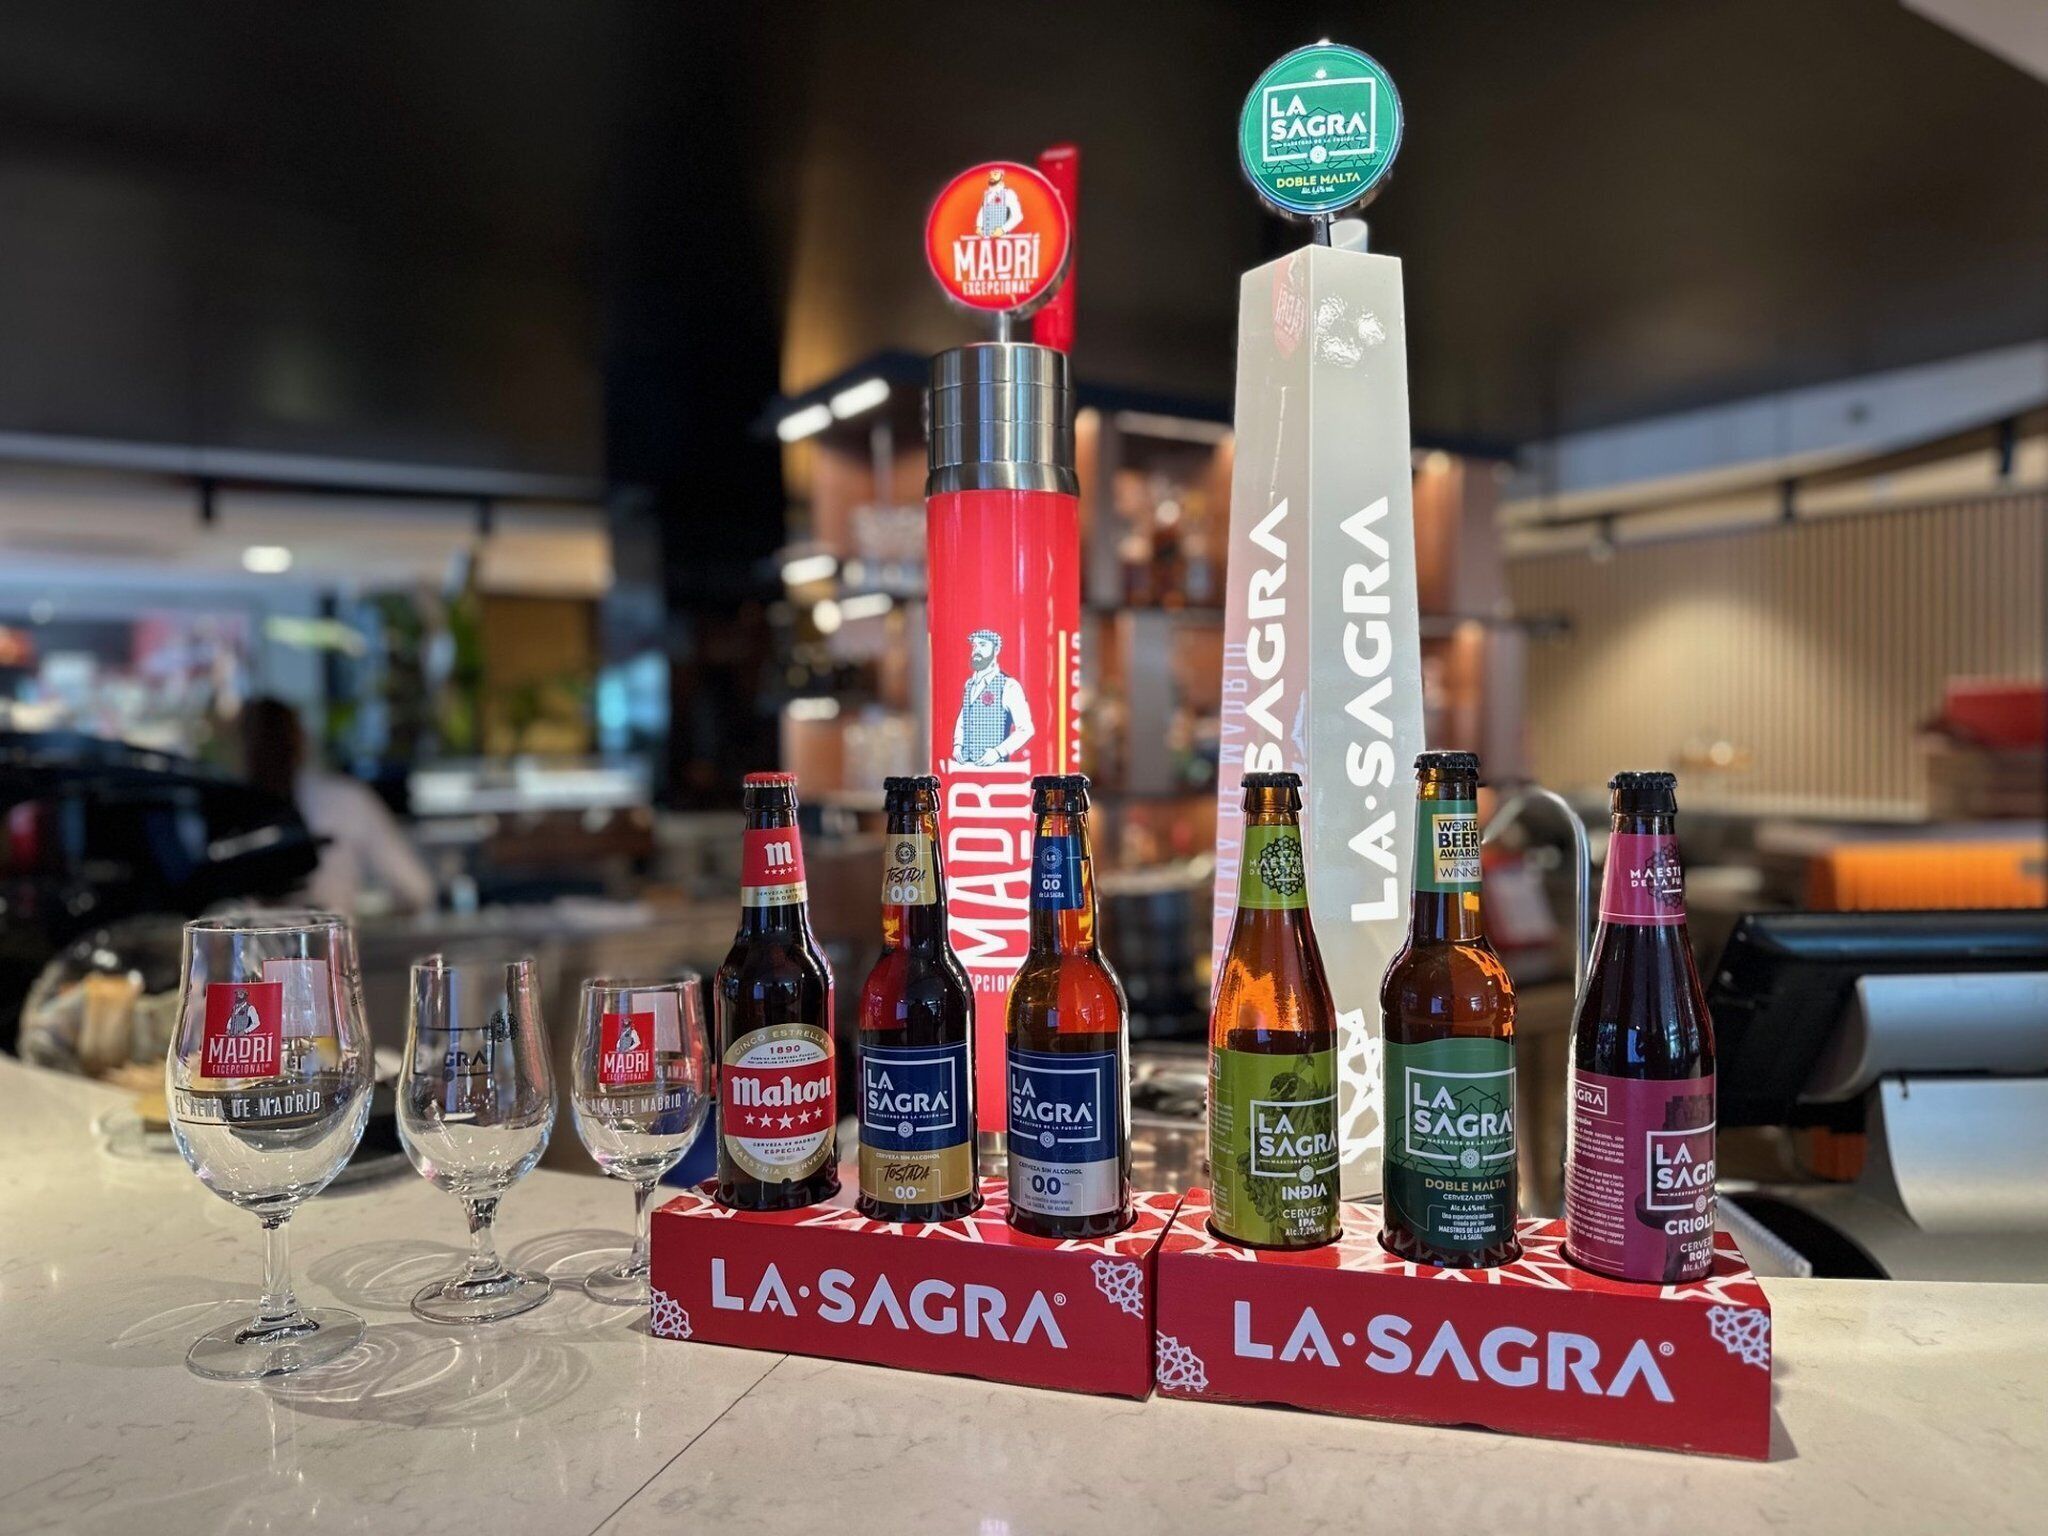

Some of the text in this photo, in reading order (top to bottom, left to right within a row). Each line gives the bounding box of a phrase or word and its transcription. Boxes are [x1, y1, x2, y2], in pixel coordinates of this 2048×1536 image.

[1271, 94, 1307, 118] LA
[1271, 112, 1367, 140] SAGRA
[1276, 172, 1361, 188] DOBLE MALTA
[953, 231, 1040, 282] MADRÍ
[1438, 821, 1478, 832] WORLD
[1438, 832, 1478, 848] BEER
[1440, 848, 1479, 857] AWARDS
[886, 867, 926, 885] TOSTADA
[1631, 879, 1647, 887] DE
[208, 1033, 273, 1063] MADRÍ
[772, 1029, 828, 1049] ESTRELLAS
[770, 1045, 800, 1054] 1890
[212, 1063, 266, 1074] EXCEPCIONAL
[867, 1068, 894, 1091] LA
[1012, 1073, 1036, 1098] LA
[731, 1075, 831, 1107] Mahou
[1413, 1082, 1456, 1110] LA
[232, 1098, 250, 1118] DE
[259, 1091, 321, 1117] MADRID
[622, 1099, 635, 1114] DE
[641, 1092, 681, 1113] MADRID
[868, 1090, 949, 1113] SAGRA
[1012, 1096, 1093, 1123] SAGRA
[1259, 1114, 1295, 1134] LA
[1414, 1108, 1513, 1137] SAGRA
[764, 1146, 806, 1154] ESPECIAL
[1260, 1130, 1336, 1157] SAGRA
[1656, 1143, 1692, 1165] LA
[884, 1163, 930, 1183] TOSTADA
[1019, 1161, 1040, 1172] CERVEZA
[1032, 1175, 1061, 1195] 0,0
[1425, 1178, 1506, 1191] DOBLE MALTA
[1443, 1193, 1494, 1201] CERVEZA EXTRA
[1283, 1205, 1328, 1219] CERVEZA
[1299, 1218, 1316, 1227] IPA
[1689, 1248, 1710, 1261] ROJA
